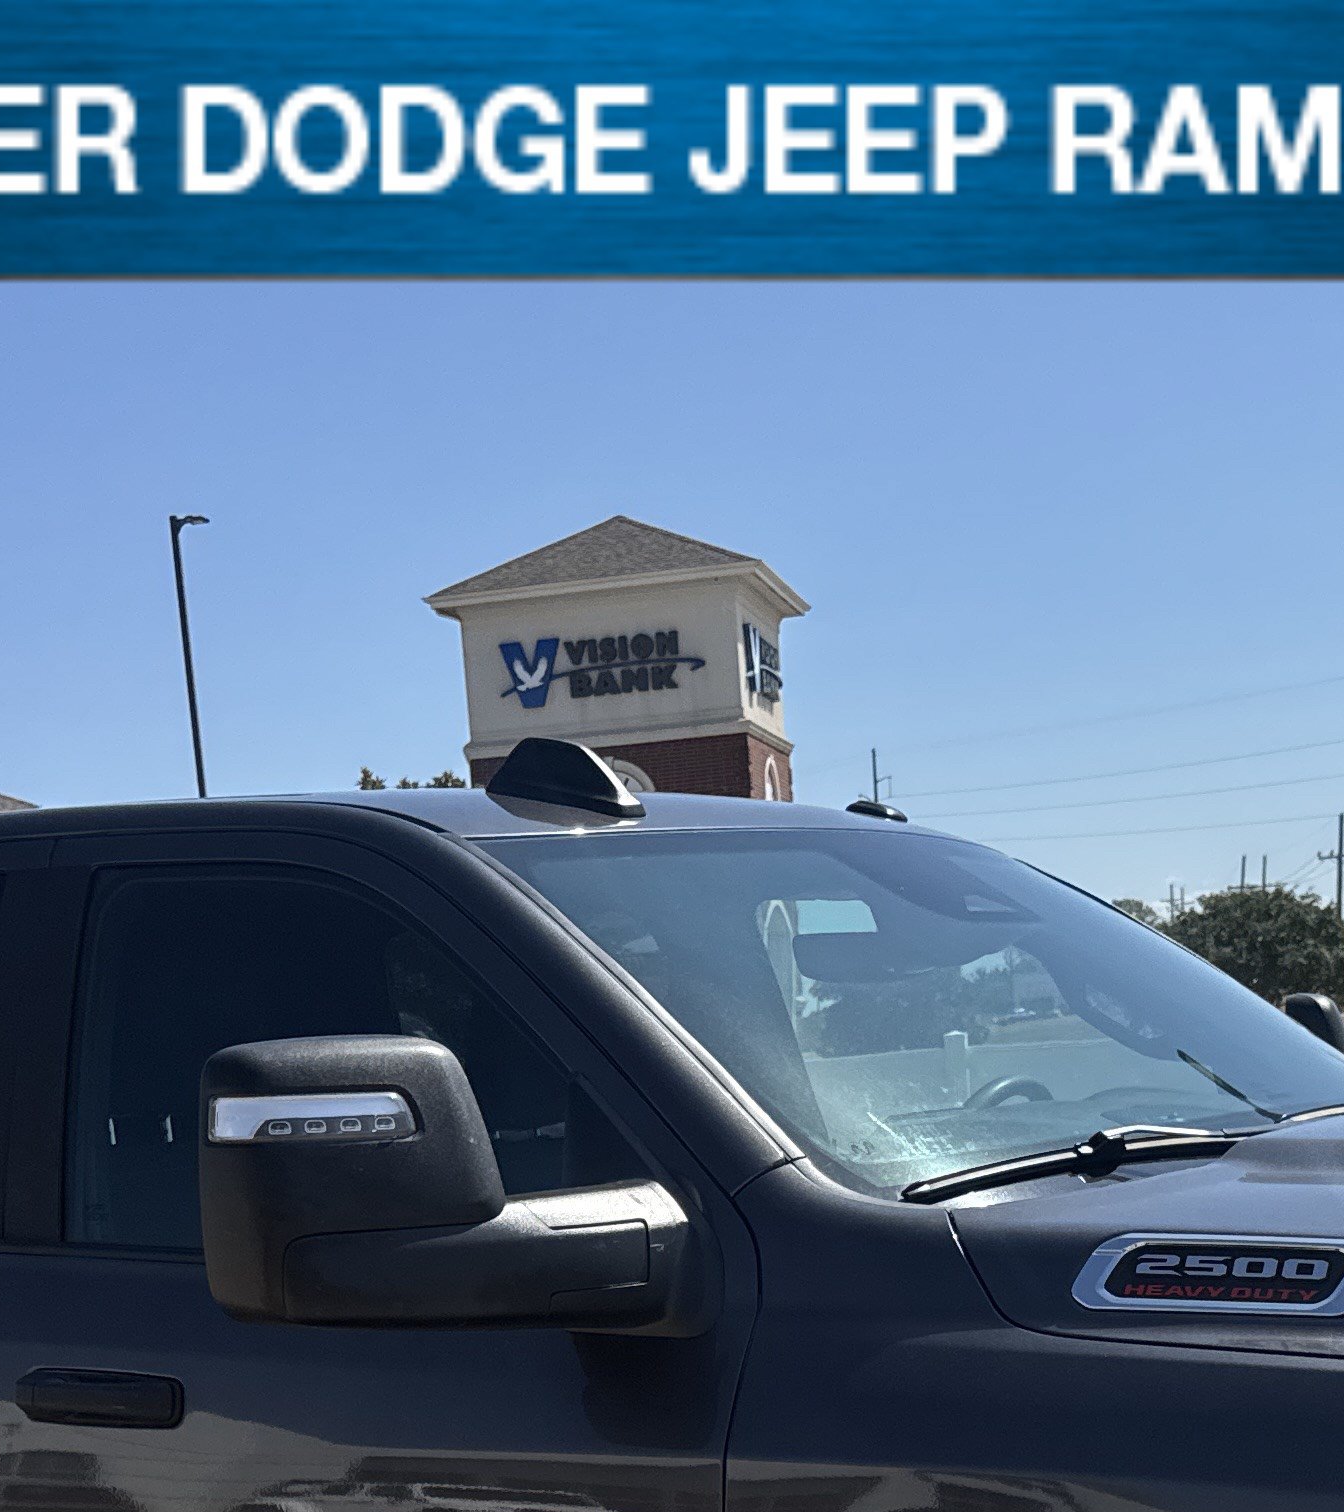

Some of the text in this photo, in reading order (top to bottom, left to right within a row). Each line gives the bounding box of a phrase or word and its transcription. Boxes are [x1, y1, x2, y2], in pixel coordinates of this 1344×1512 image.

[564, 630, 680, 666] VISION
[569, 664, 679, 699] BANK
[1135, 1253, 1330, 1281] 2500
[1123, 1284, 1320, 1301] HEAVY DUTY
